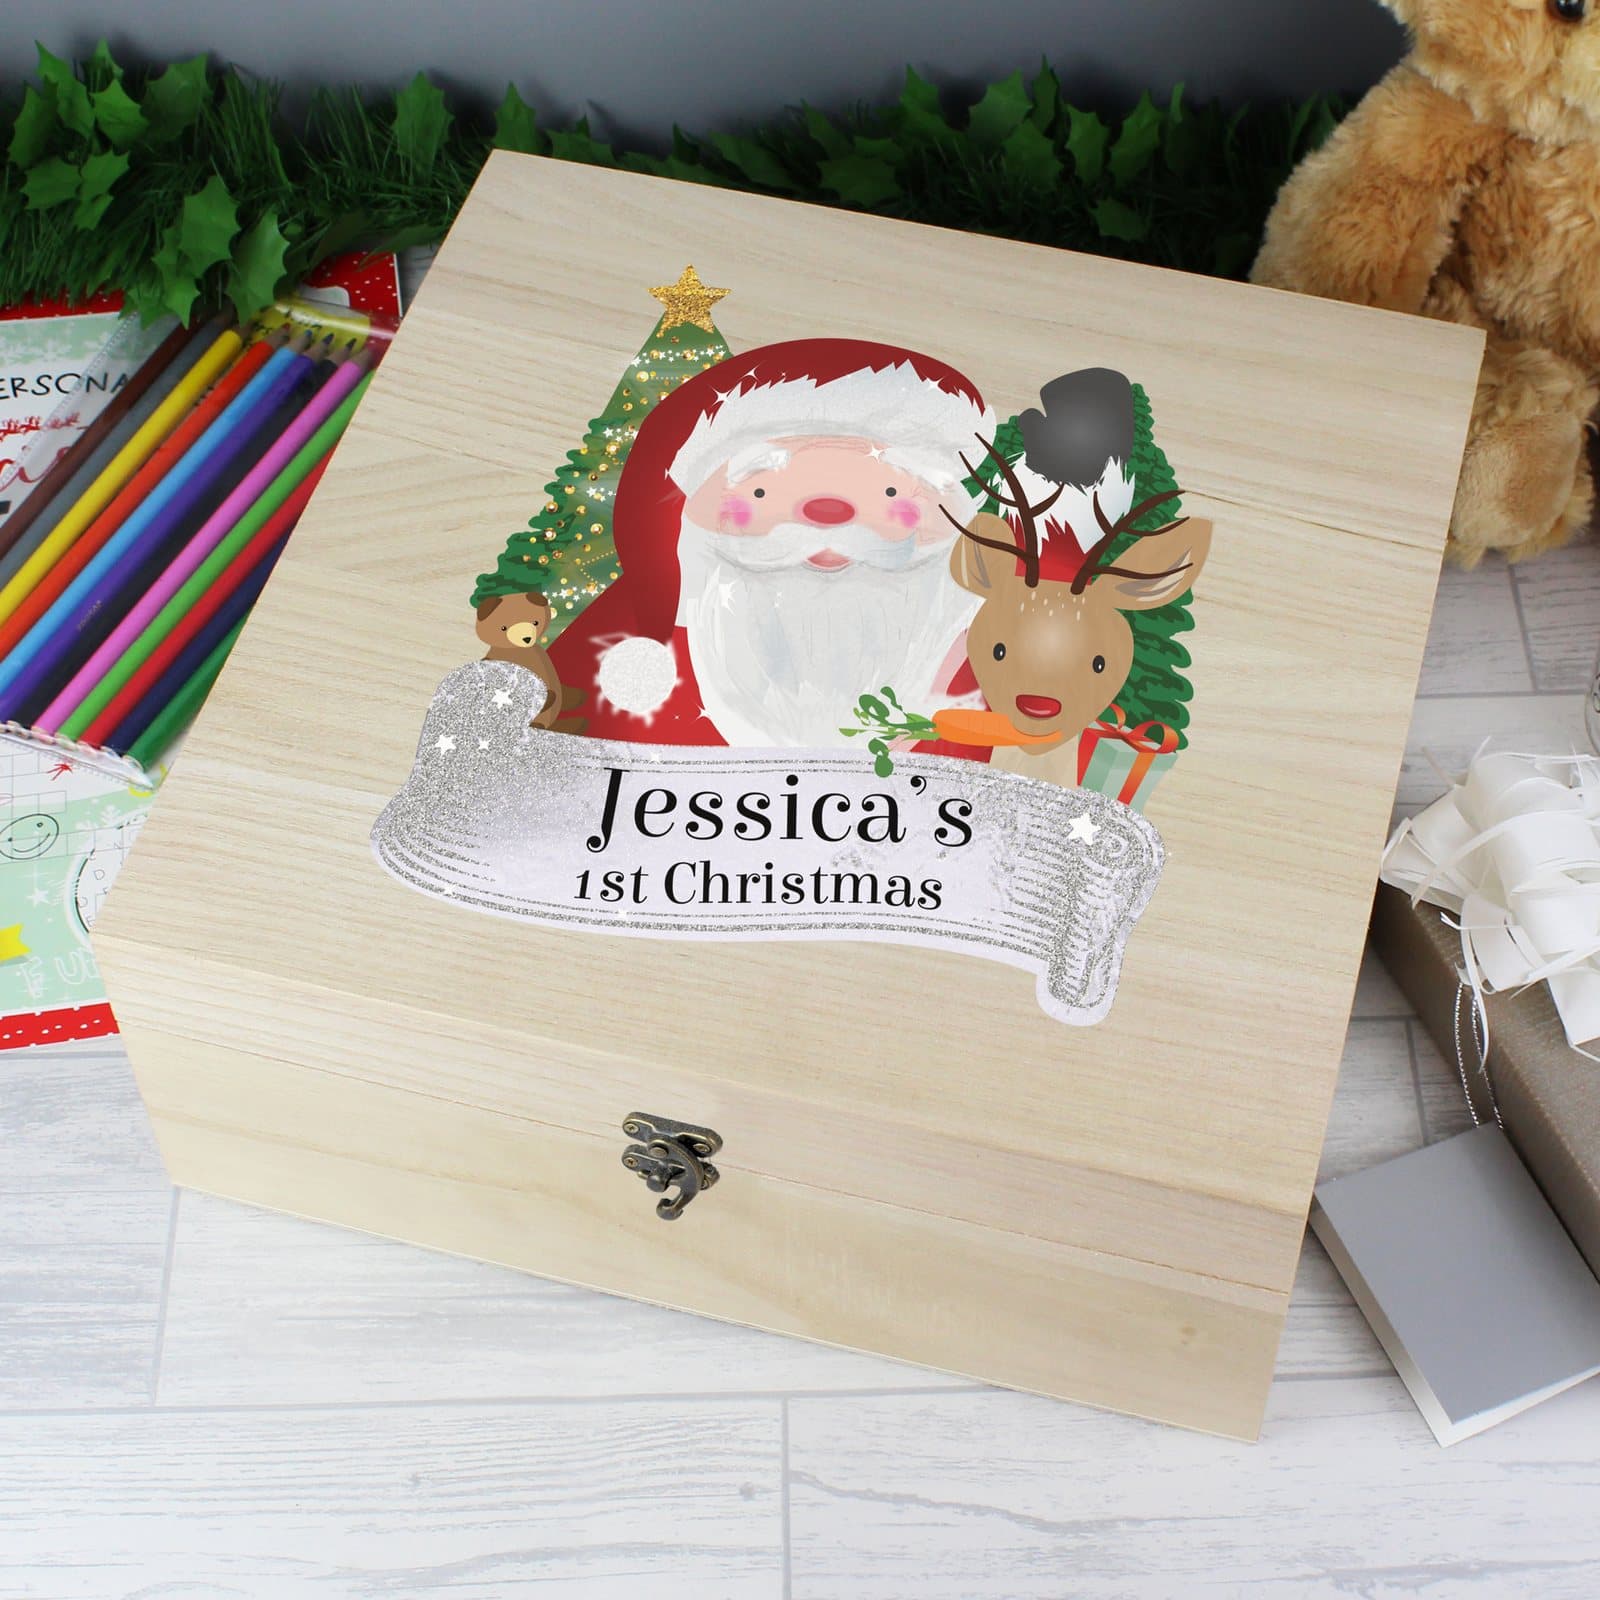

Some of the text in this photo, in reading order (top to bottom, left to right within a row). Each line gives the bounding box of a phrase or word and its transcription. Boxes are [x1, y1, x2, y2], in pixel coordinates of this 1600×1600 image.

[586, 767, 973, 853] Jessica's
[574, 860, 942, 910] 1st Christmas
